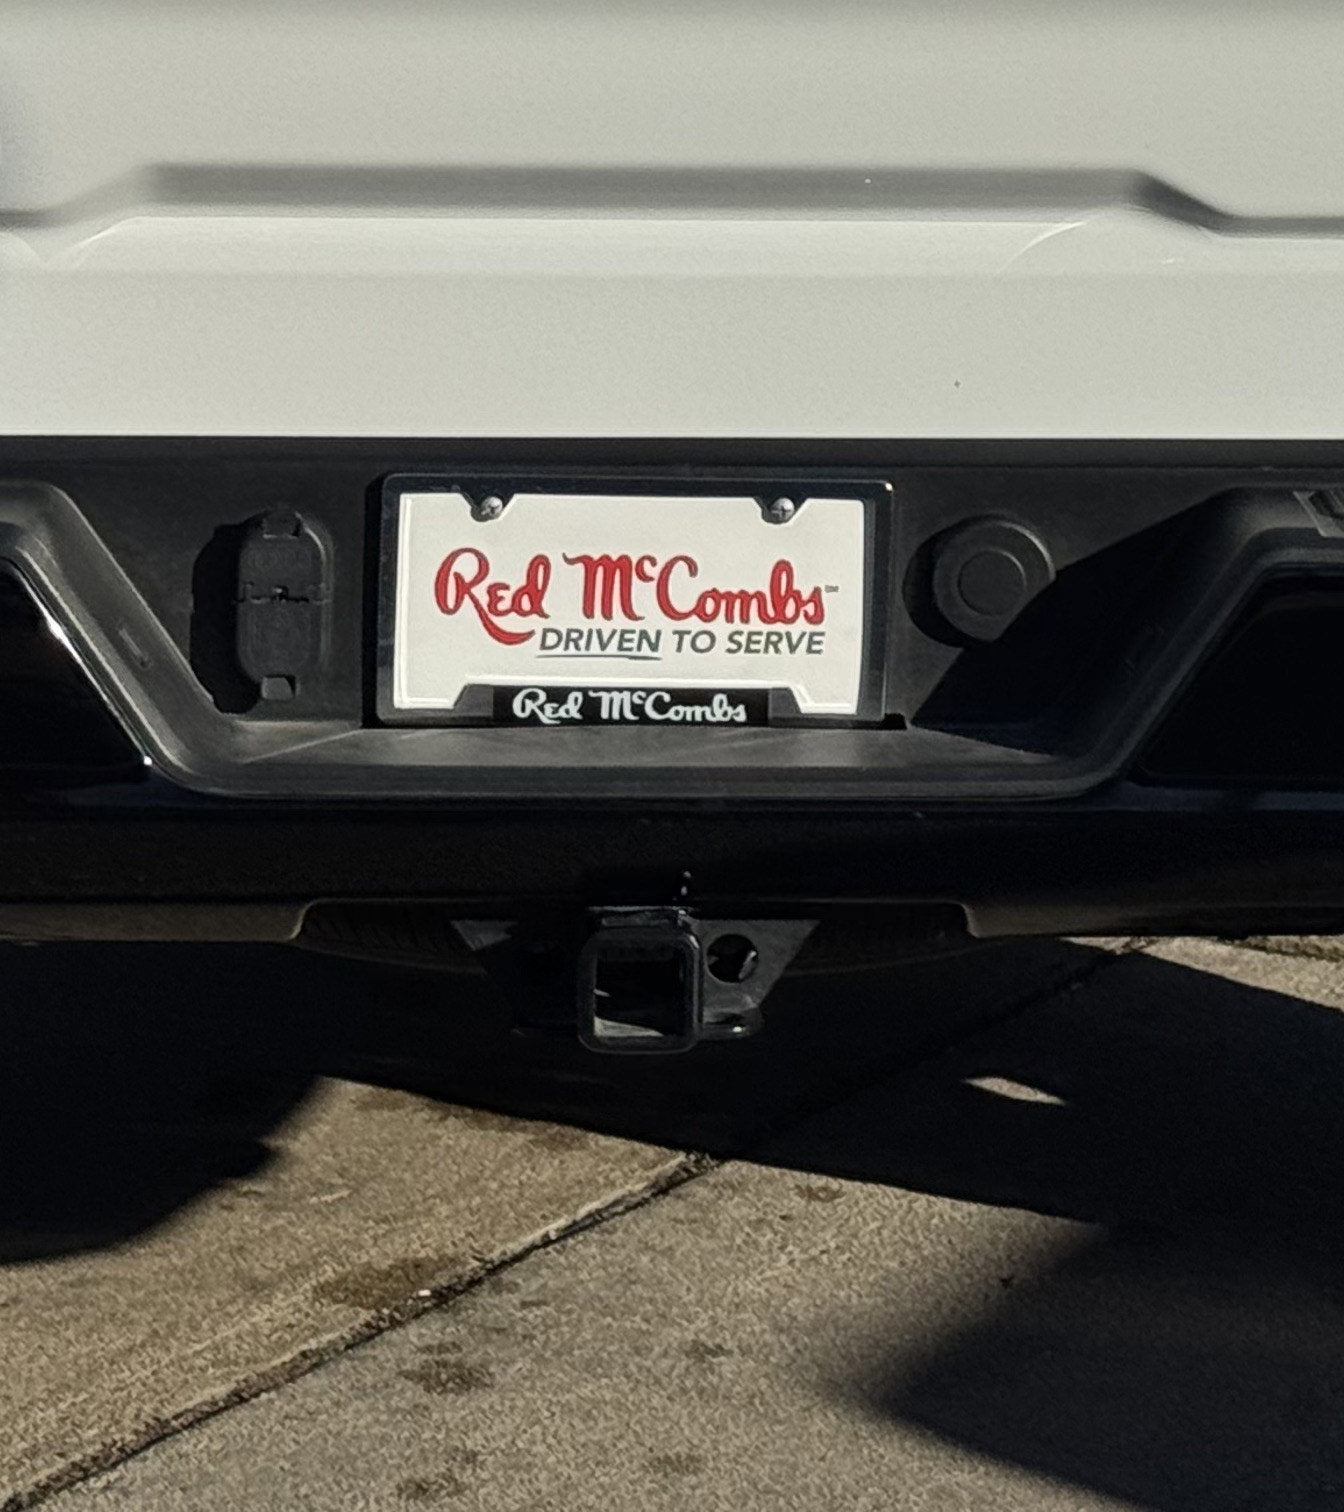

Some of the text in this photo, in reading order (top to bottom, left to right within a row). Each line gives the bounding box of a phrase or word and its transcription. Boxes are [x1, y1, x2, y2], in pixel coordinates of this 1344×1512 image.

[434, 547, 825, 645] Red McCombs
[539, 628, 826, 655] DRIVEN TO SERVE
[512, 688, 748, 724] Red McCombs
